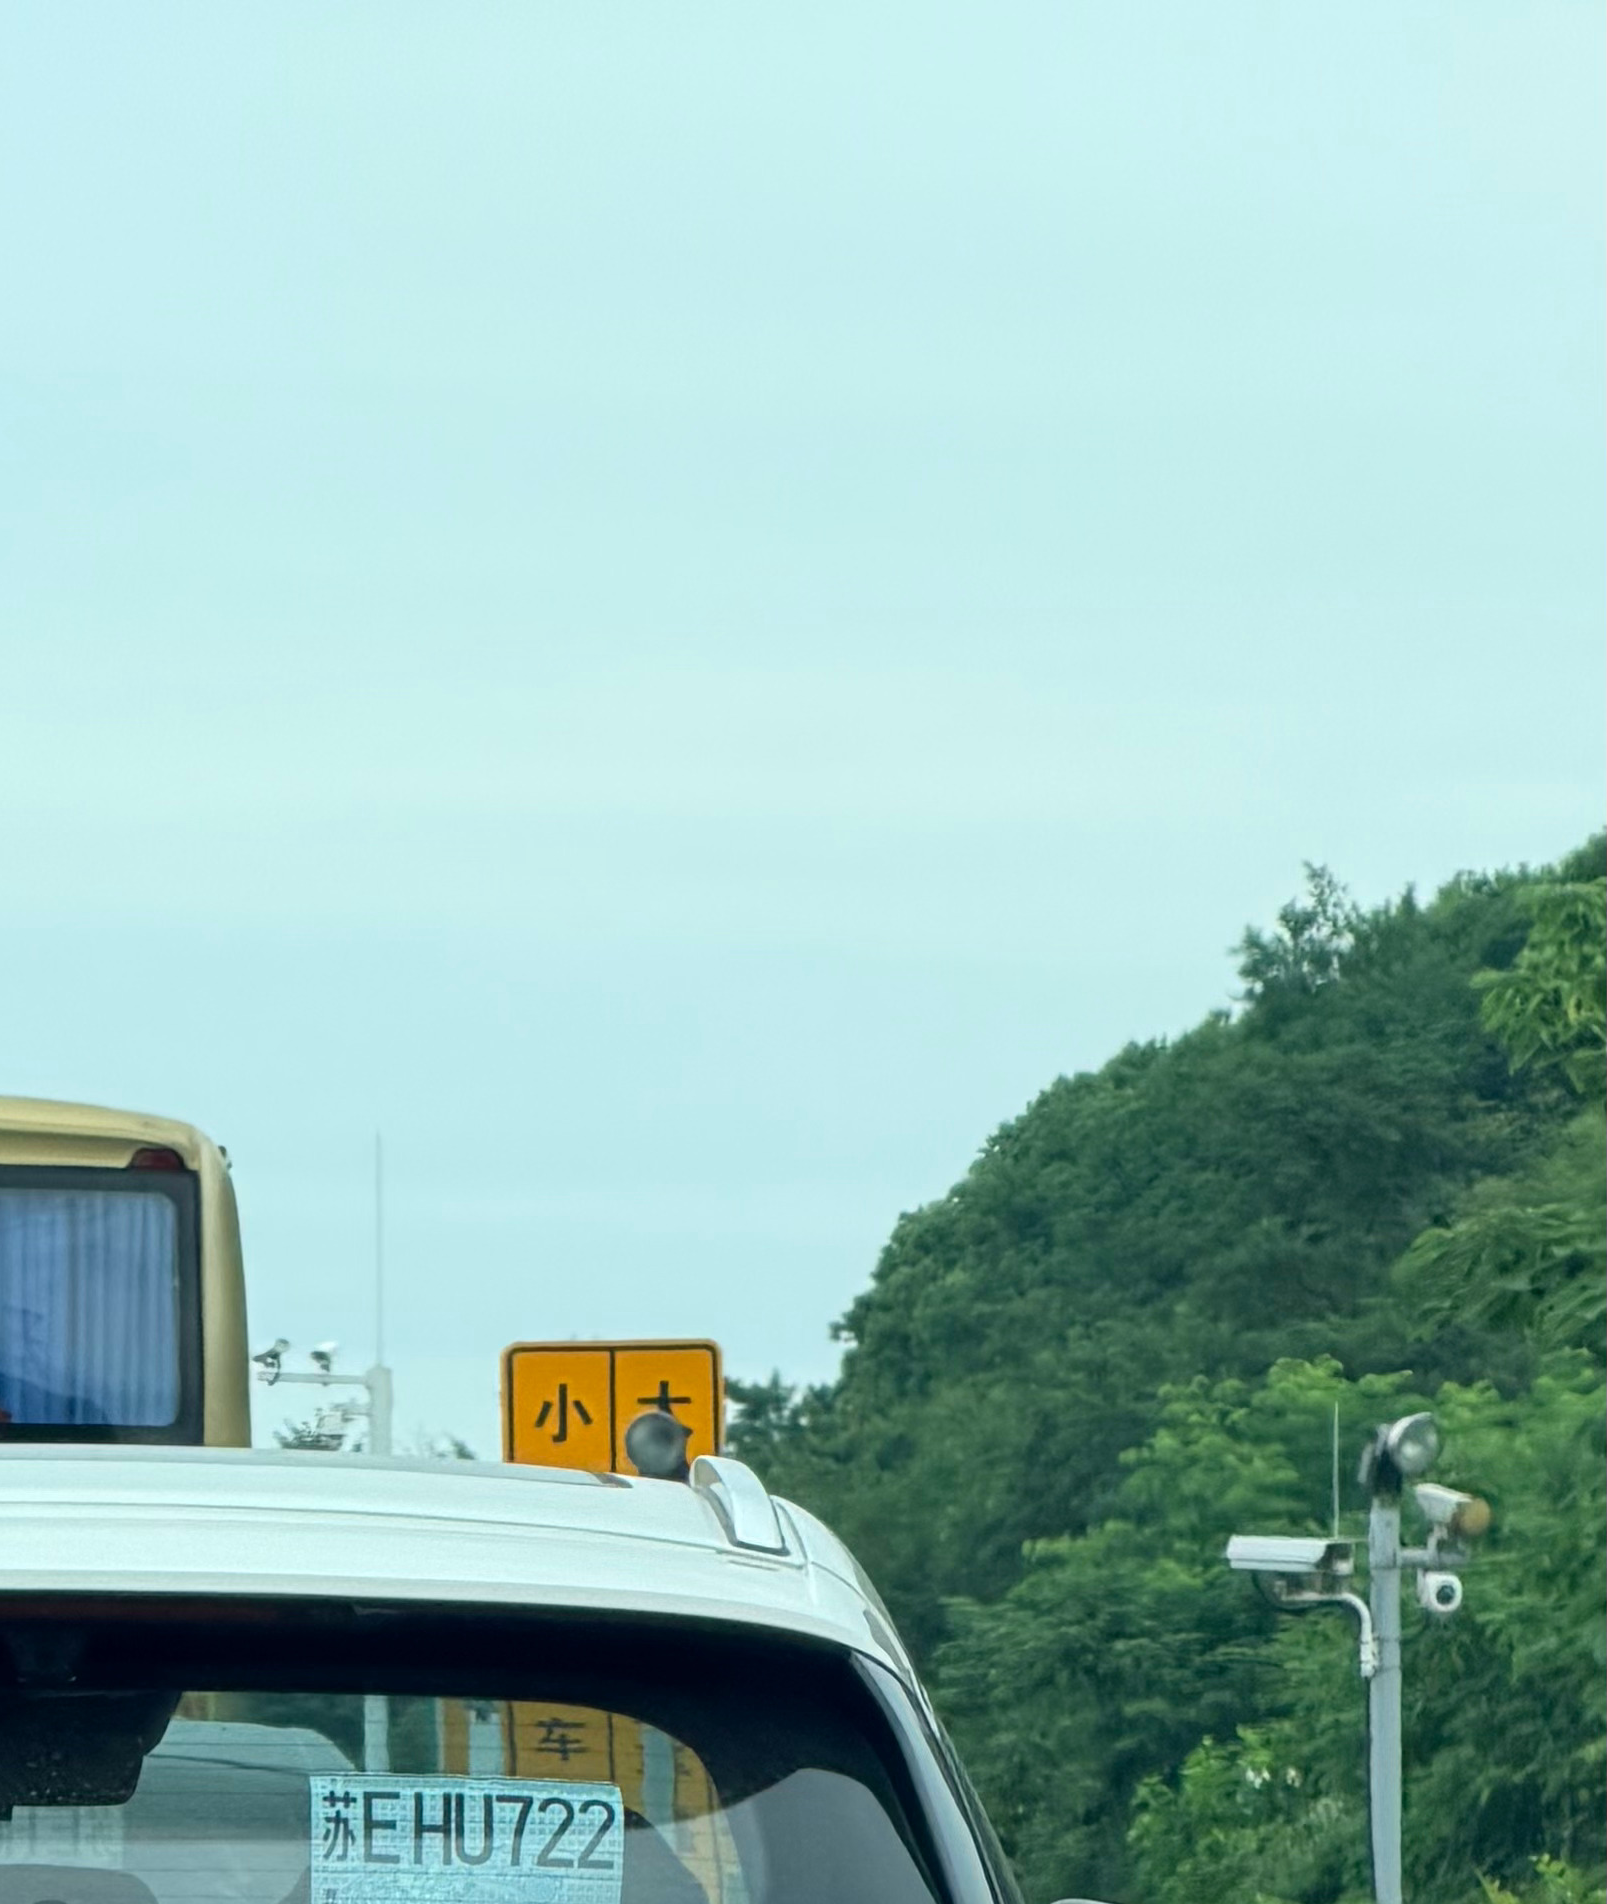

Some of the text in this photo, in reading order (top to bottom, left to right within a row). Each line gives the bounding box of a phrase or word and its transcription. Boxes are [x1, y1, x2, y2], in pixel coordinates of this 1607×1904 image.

[534, 1382, 592, 1443] 小
[536, 1717, 587, 1760] 车
[322, 1790, 614, 1870] 苏EHU722
